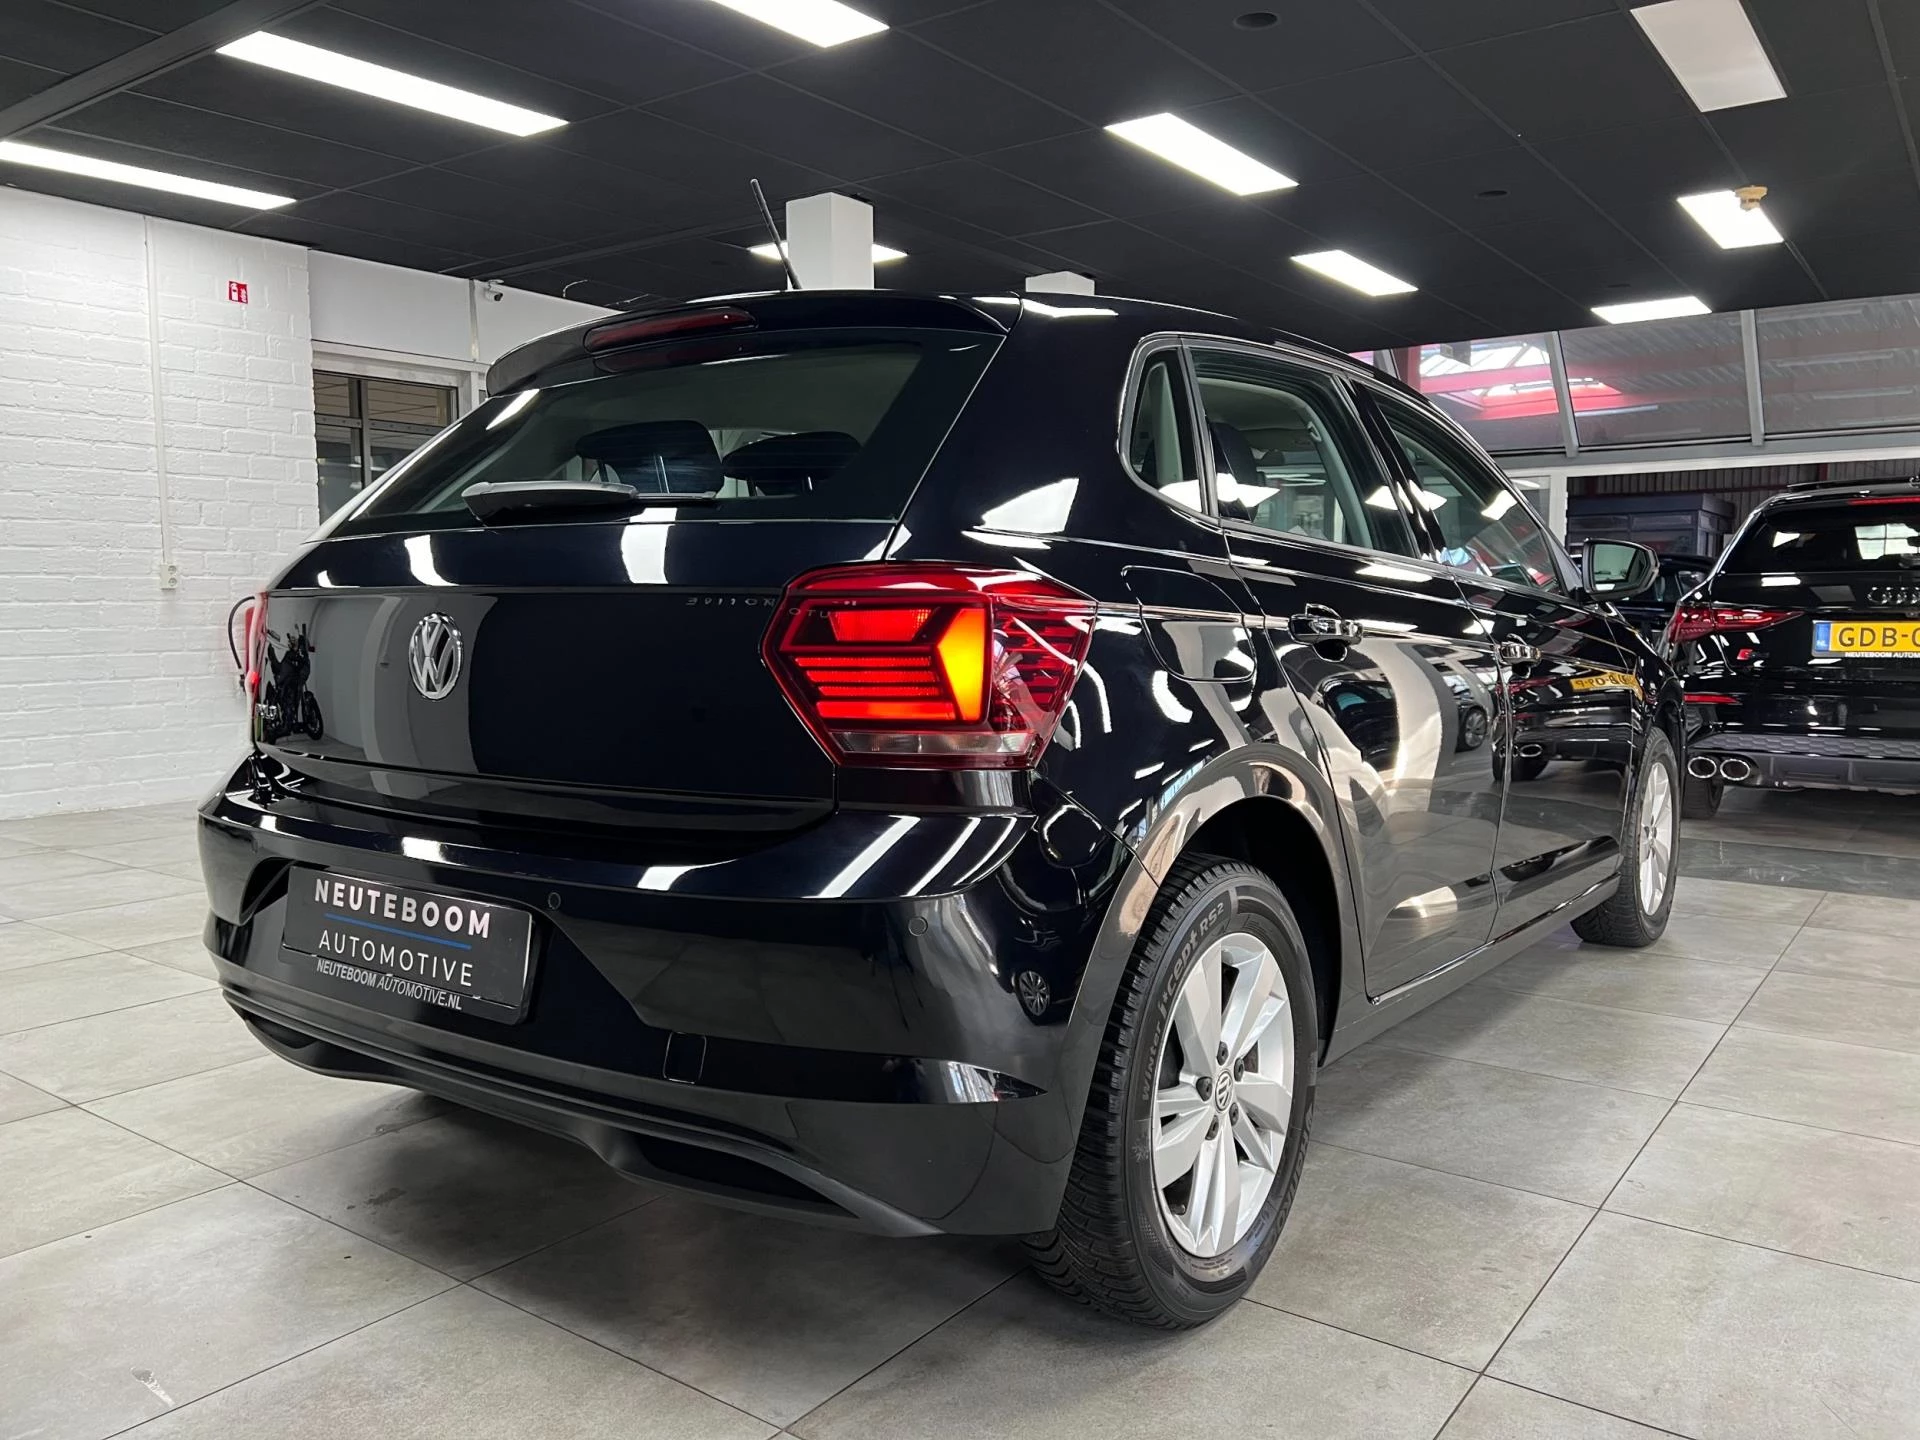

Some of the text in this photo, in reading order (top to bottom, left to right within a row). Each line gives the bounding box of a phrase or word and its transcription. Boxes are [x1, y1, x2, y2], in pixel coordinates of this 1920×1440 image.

[314, 878, 490, 939] NEUTEBOOM
[316, 959, 463, 1011] NEUTEBOOM AUTOMOTIVE.NL
[318, 929, 473, 987] AUTOMOTIVE
